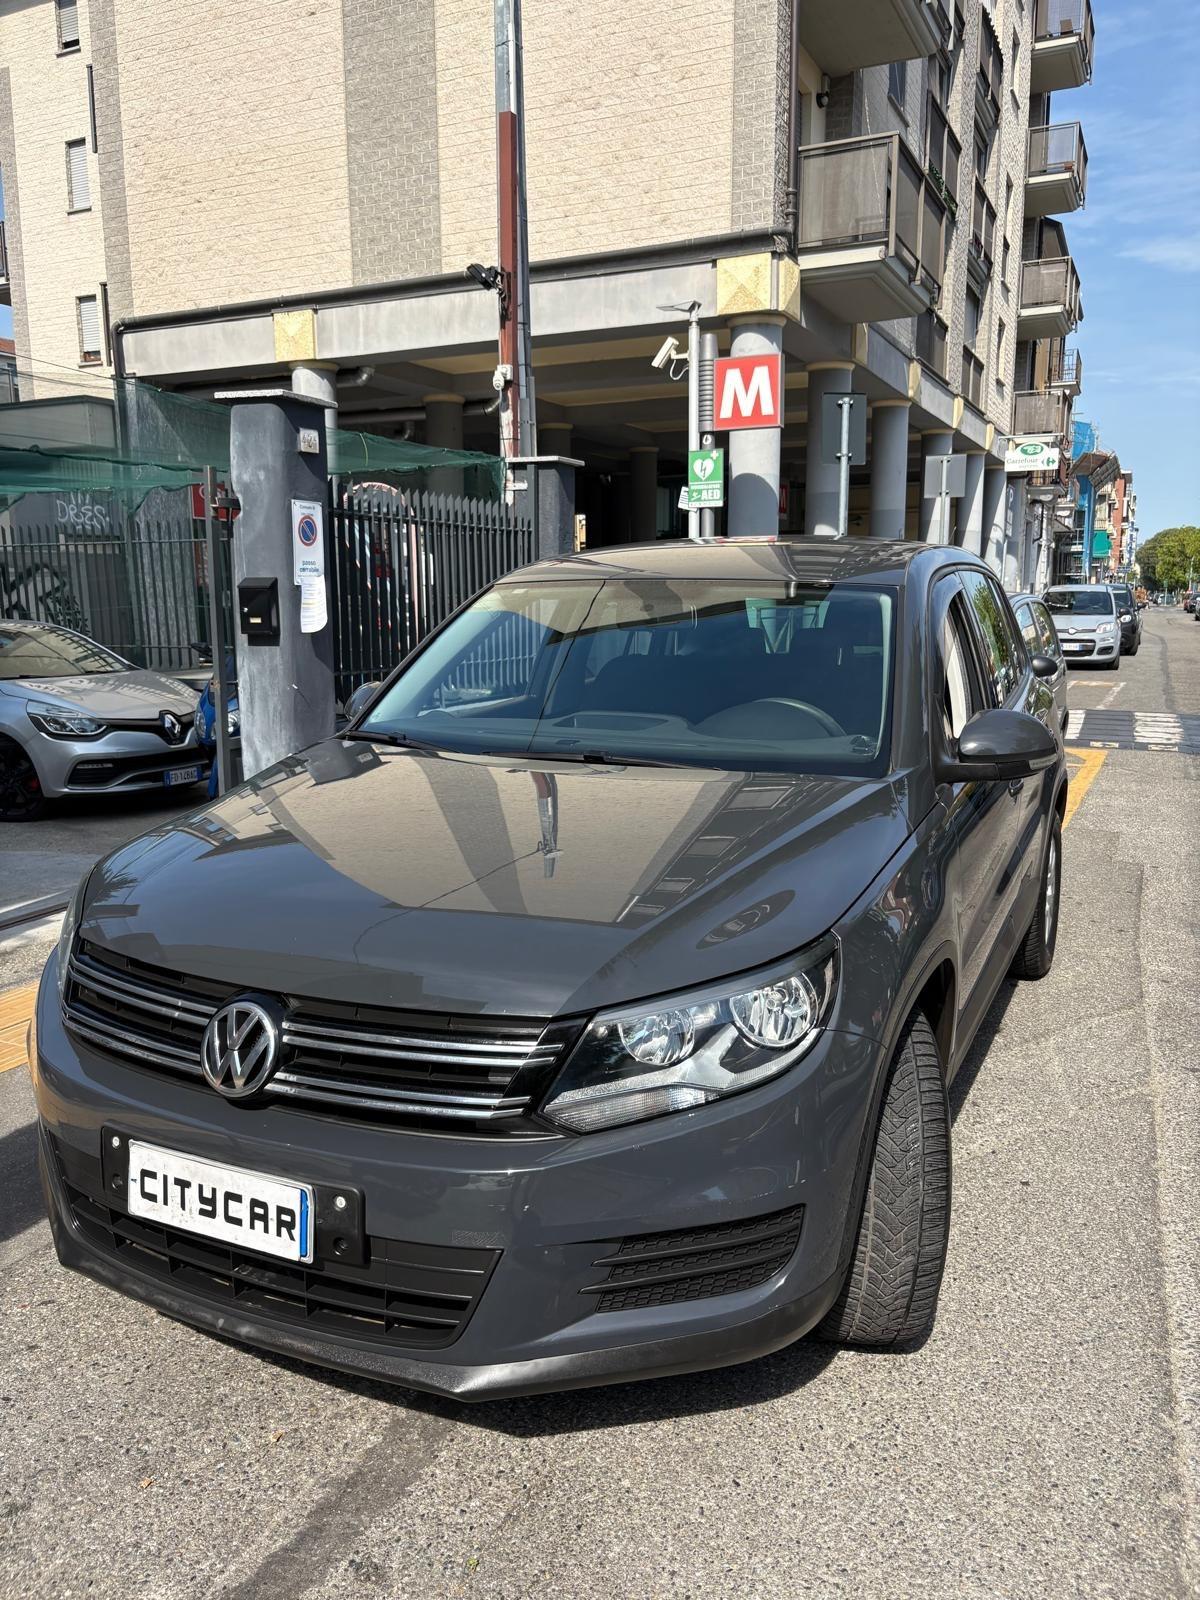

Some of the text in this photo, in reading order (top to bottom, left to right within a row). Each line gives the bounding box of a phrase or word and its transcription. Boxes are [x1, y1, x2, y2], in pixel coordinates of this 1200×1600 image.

[719, 365, 775, 419] M
[1006, 457, 1039, 465] Carrefour
[701, 489, 721, 501] AED
[140, 1168, 296, 1242] CITYCAR
